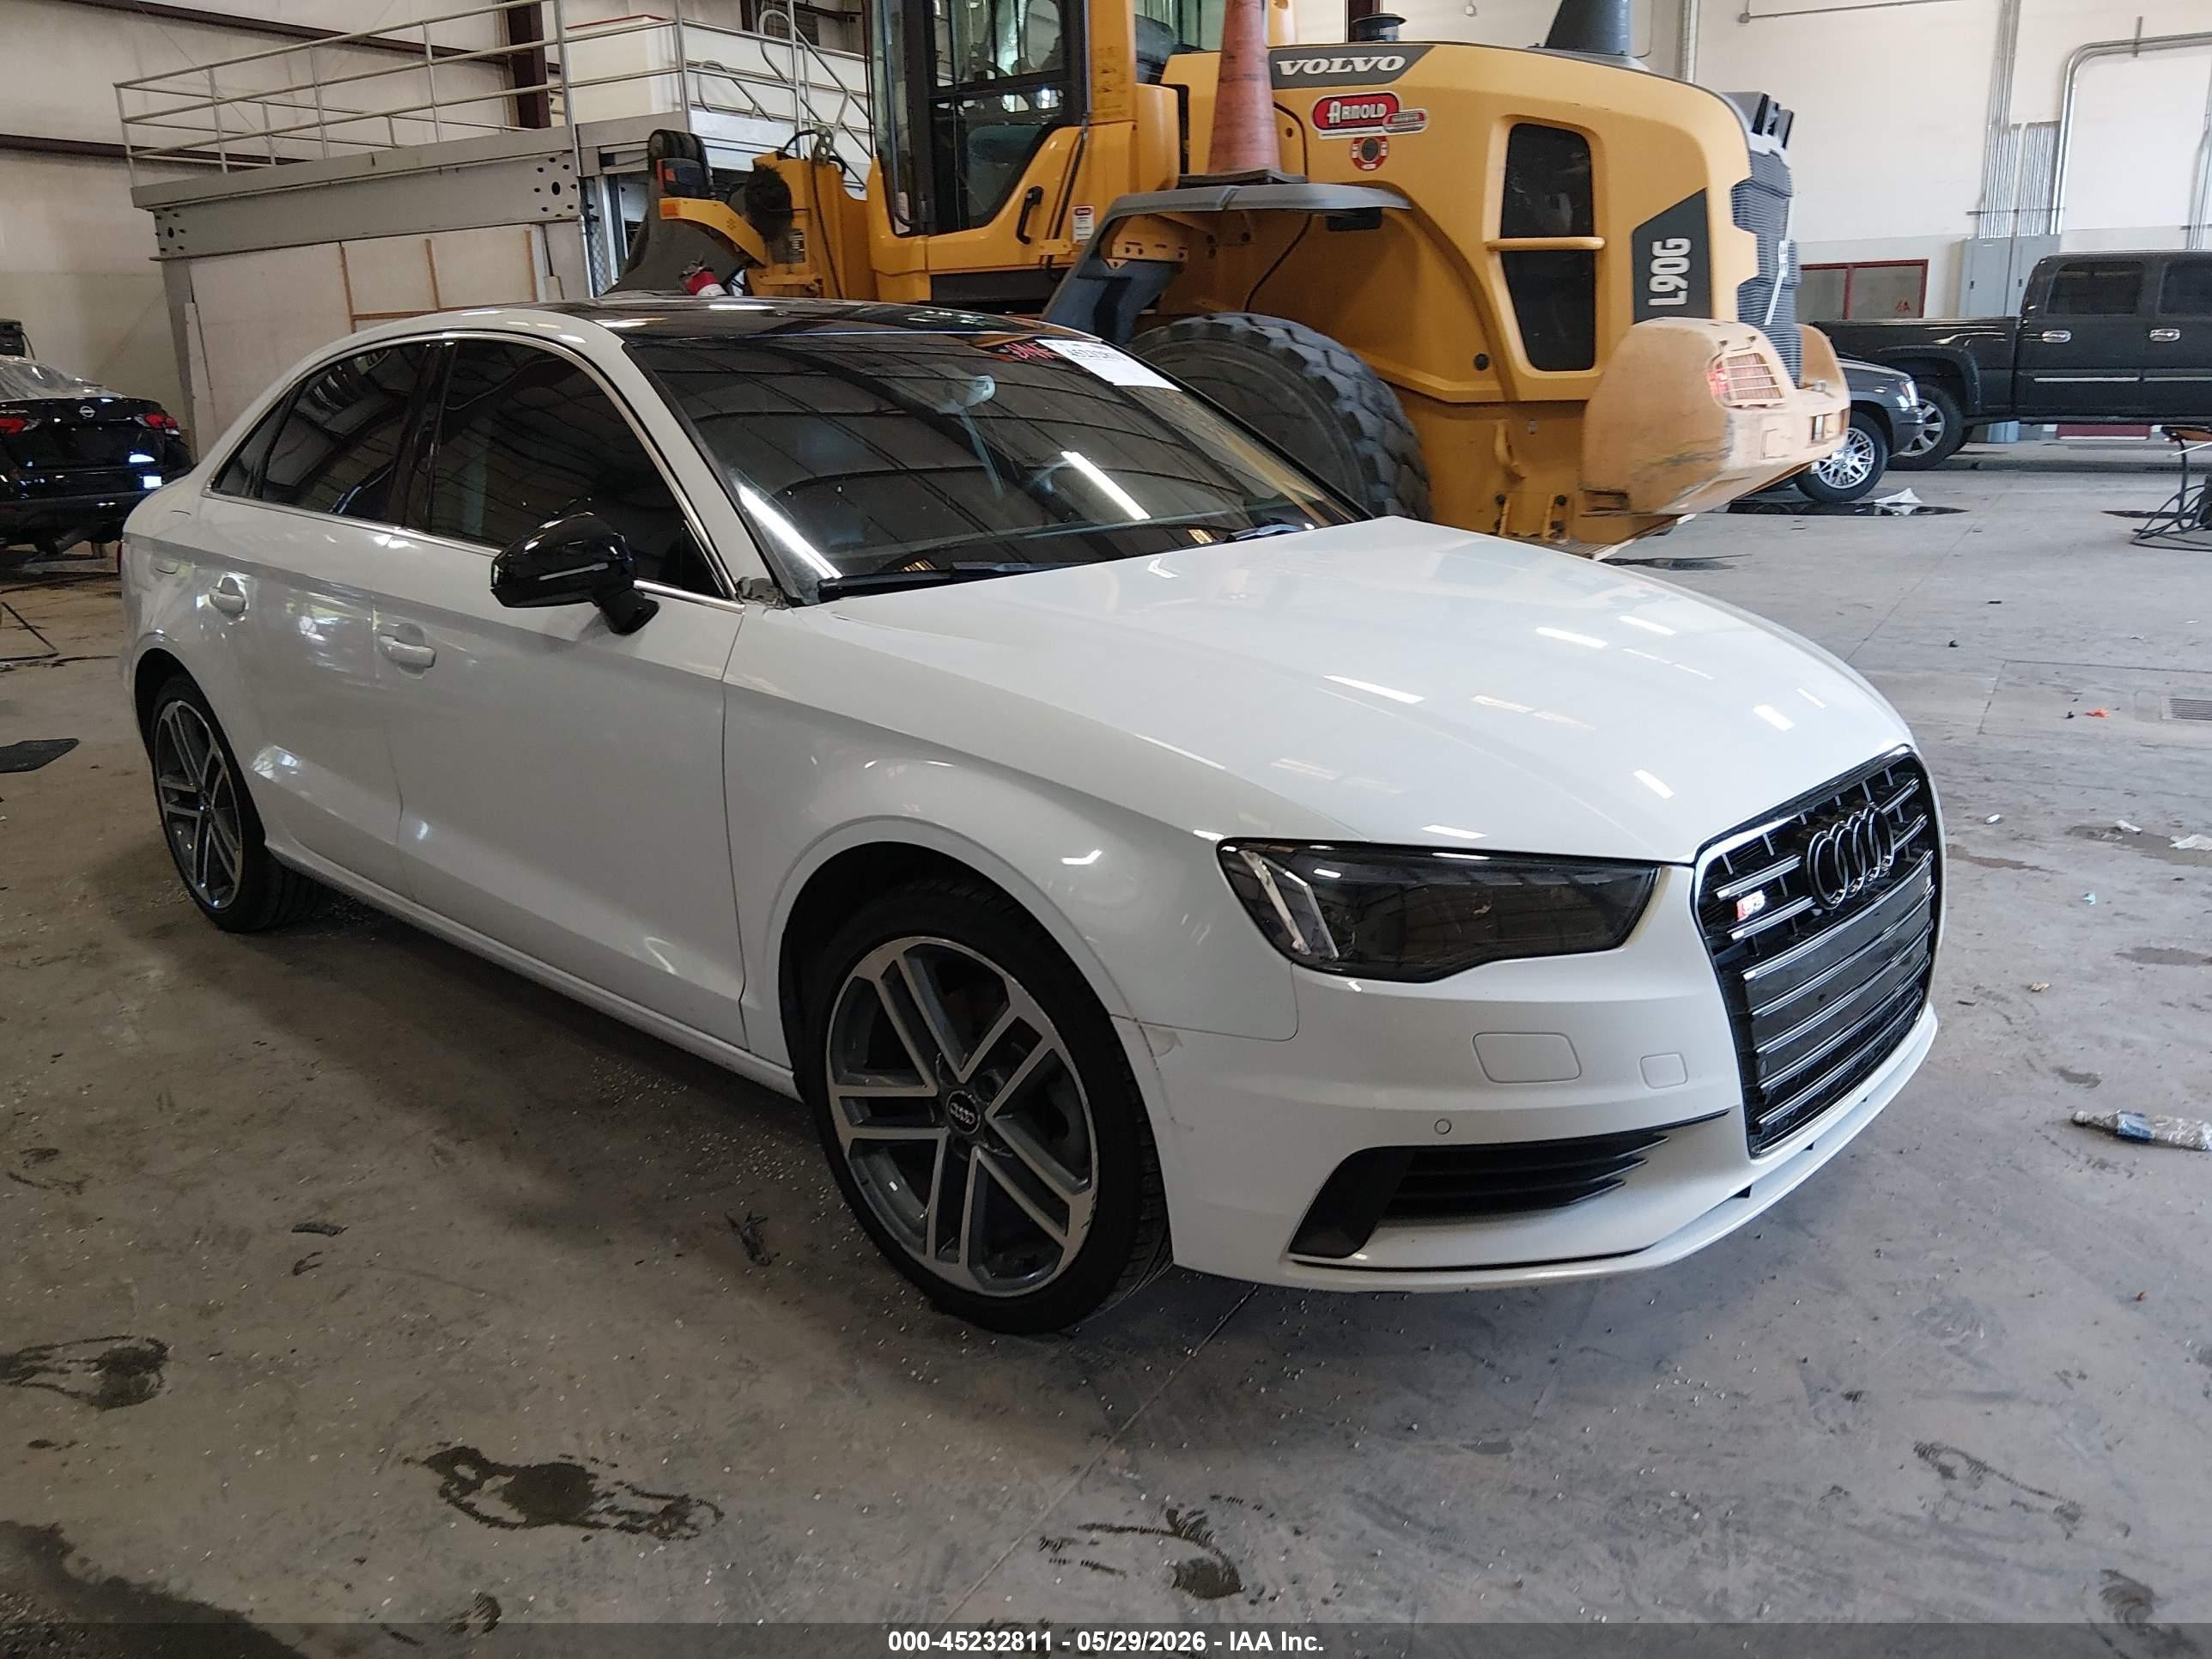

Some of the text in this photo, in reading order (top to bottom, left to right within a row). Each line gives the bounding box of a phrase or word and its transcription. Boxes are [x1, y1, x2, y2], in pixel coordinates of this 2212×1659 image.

[1276, 56, 1407, 76] VOLVO
[1327, 100, 1388, 124] ARNOLD
[1649, 238, 1692, 306] L90G
